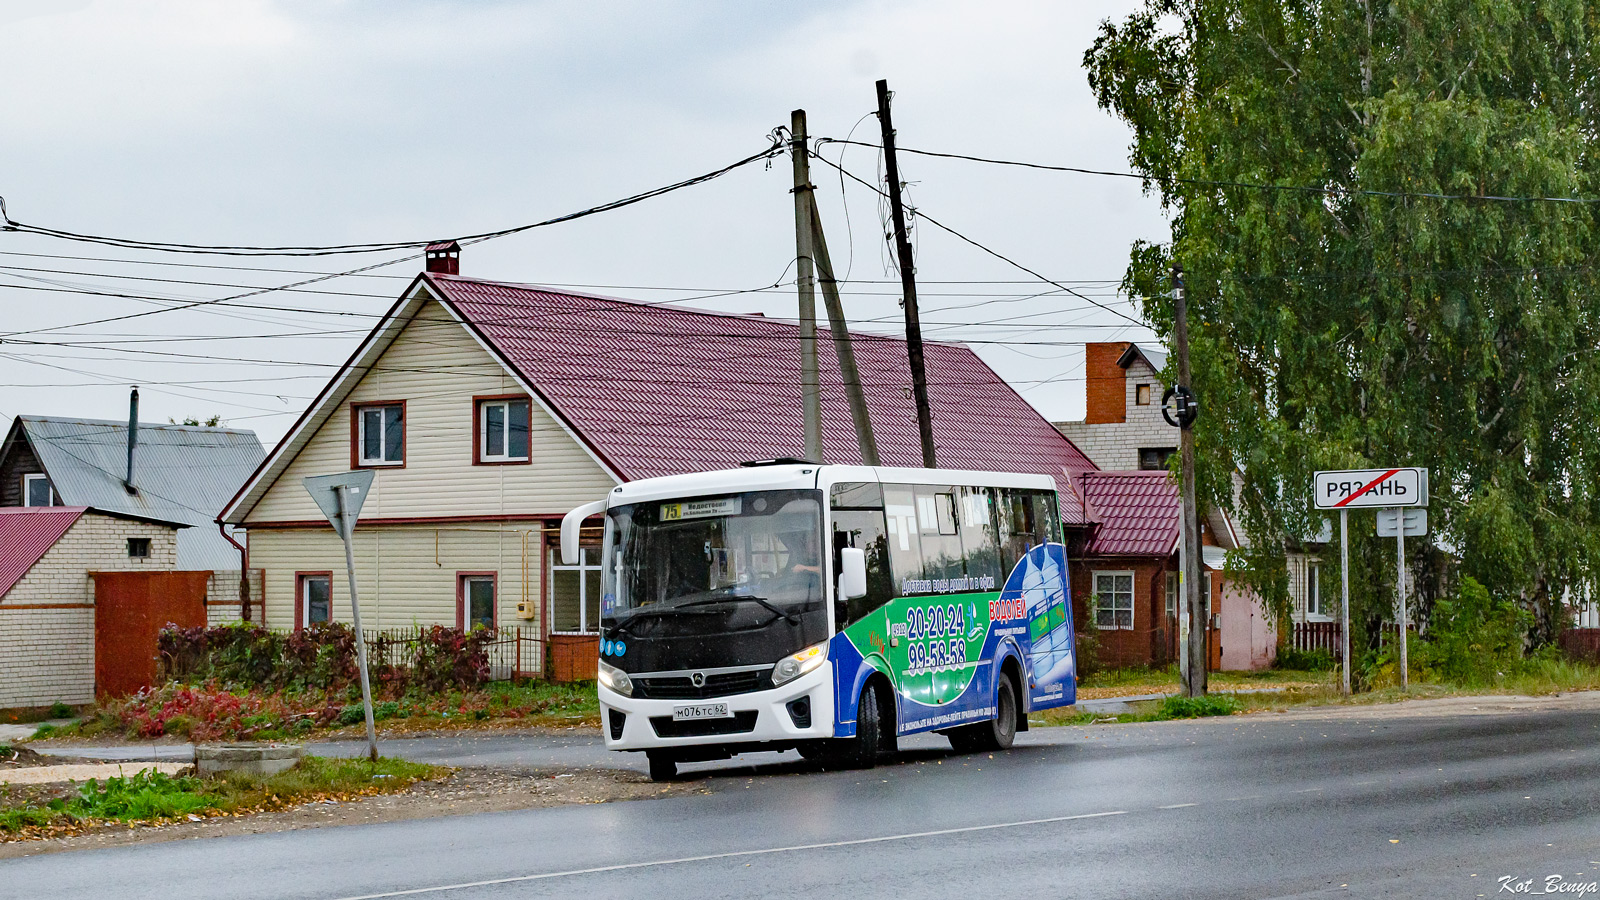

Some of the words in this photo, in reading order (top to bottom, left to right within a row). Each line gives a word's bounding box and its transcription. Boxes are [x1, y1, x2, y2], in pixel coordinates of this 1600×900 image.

[1326, 480, 1407, 498] РЯЗАНЬ
[664, 504, 678, 519] 75
[902, 577, 931, 596] Доставка
[932, 578, 949, 593] воды
[949, 574, 969, 593] домой
[969, 577, 974, 590] и
[974, 577, 979, 589] в
[907, 603, 965, 640] 20-20-24
[988, 592, 1027, 625] ВОДОЛЕЙ
[908, 638, 966, 677] 99-58-58
